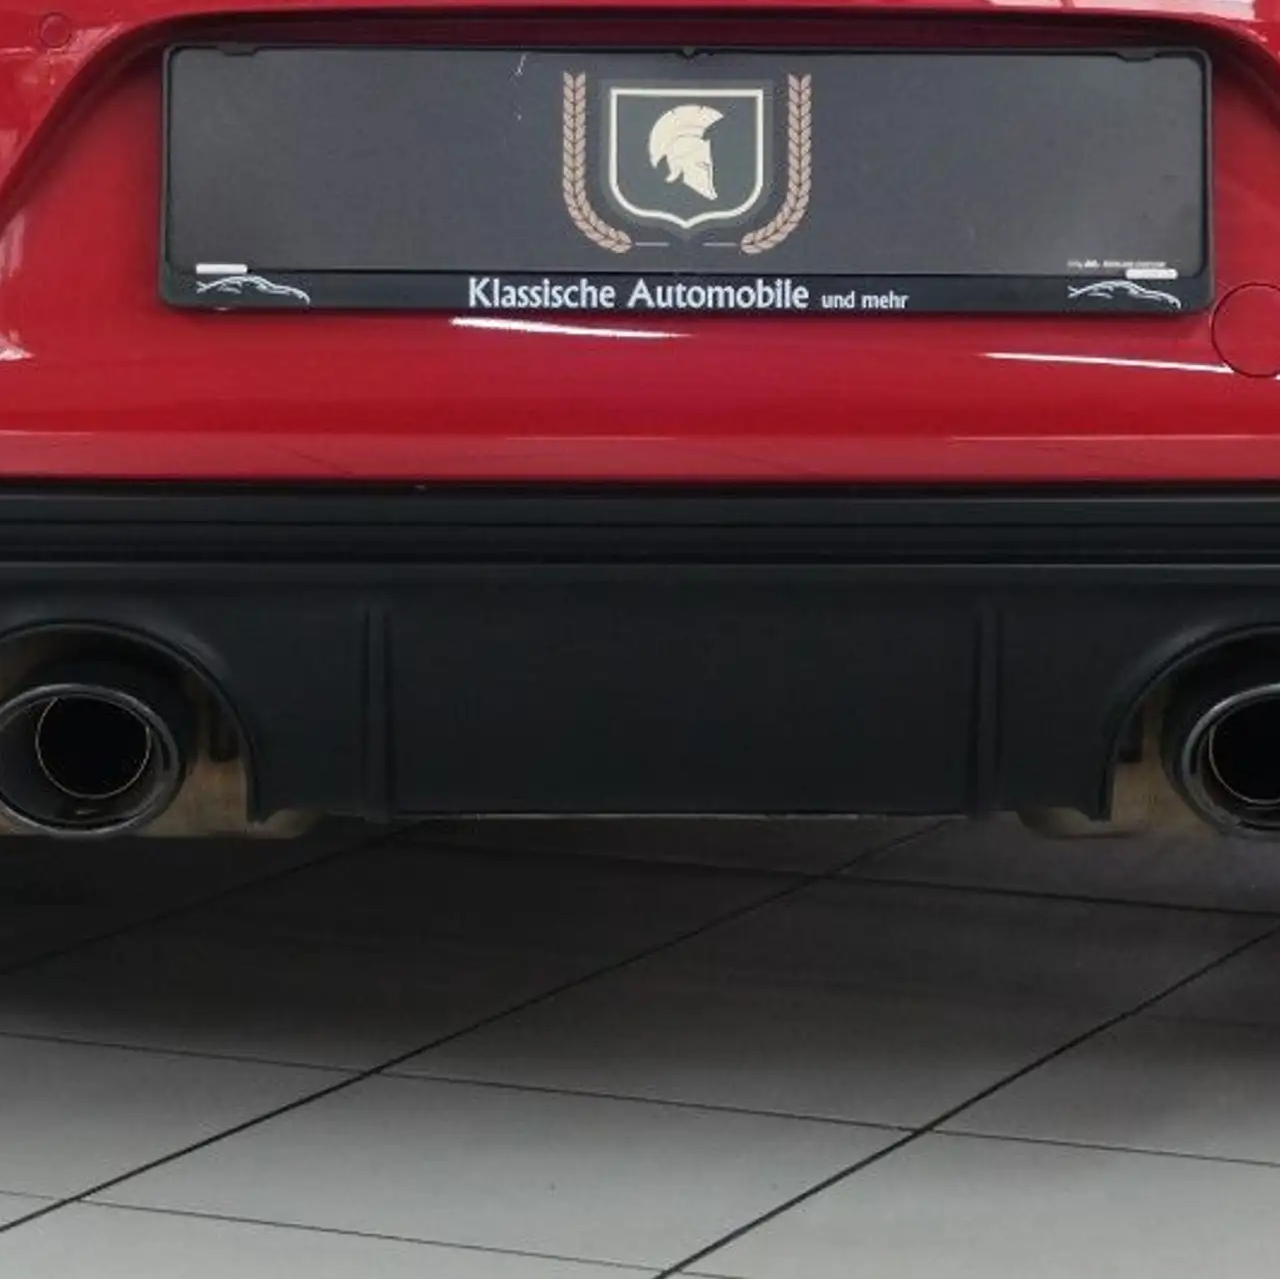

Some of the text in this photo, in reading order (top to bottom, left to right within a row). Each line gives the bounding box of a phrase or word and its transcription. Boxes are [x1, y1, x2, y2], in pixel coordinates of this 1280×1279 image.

[468, 277, 910, 311] Klassische Automobile und mehr
